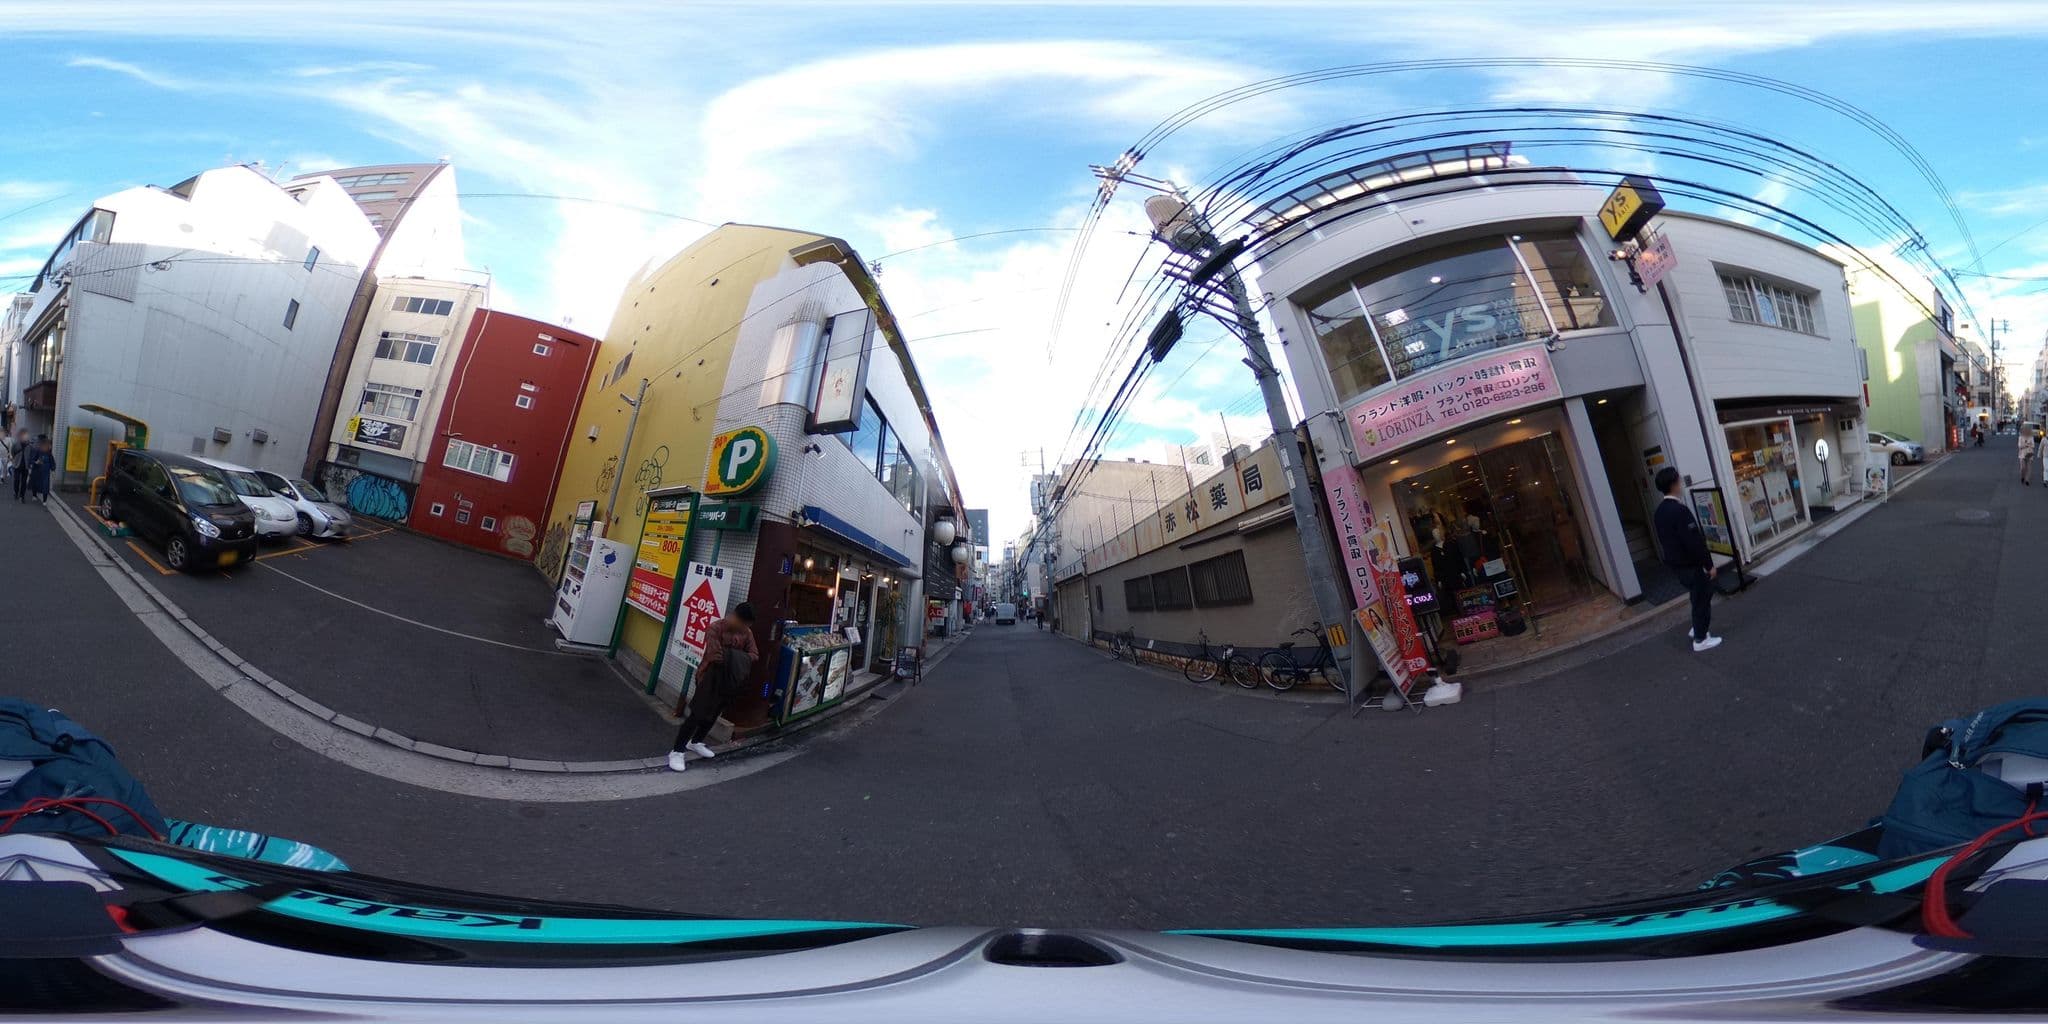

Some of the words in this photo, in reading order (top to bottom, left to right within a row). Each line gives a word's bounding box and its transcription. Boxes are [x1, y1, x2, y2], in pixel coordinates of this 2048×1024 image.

[1440, 407, 1463, 419] TEL
[1378, 411, 1436, 442] LORINZA
[727, 438, 757, 480] P
[1164, 463, 1263, 534] 赤松薬局
[694, 564, 724, 580] 駐輪場
[1356, 566, 1373, 601] ロリン
[690, 596, 715, 615] この先
[690, 611, 709, 629] すぐ
